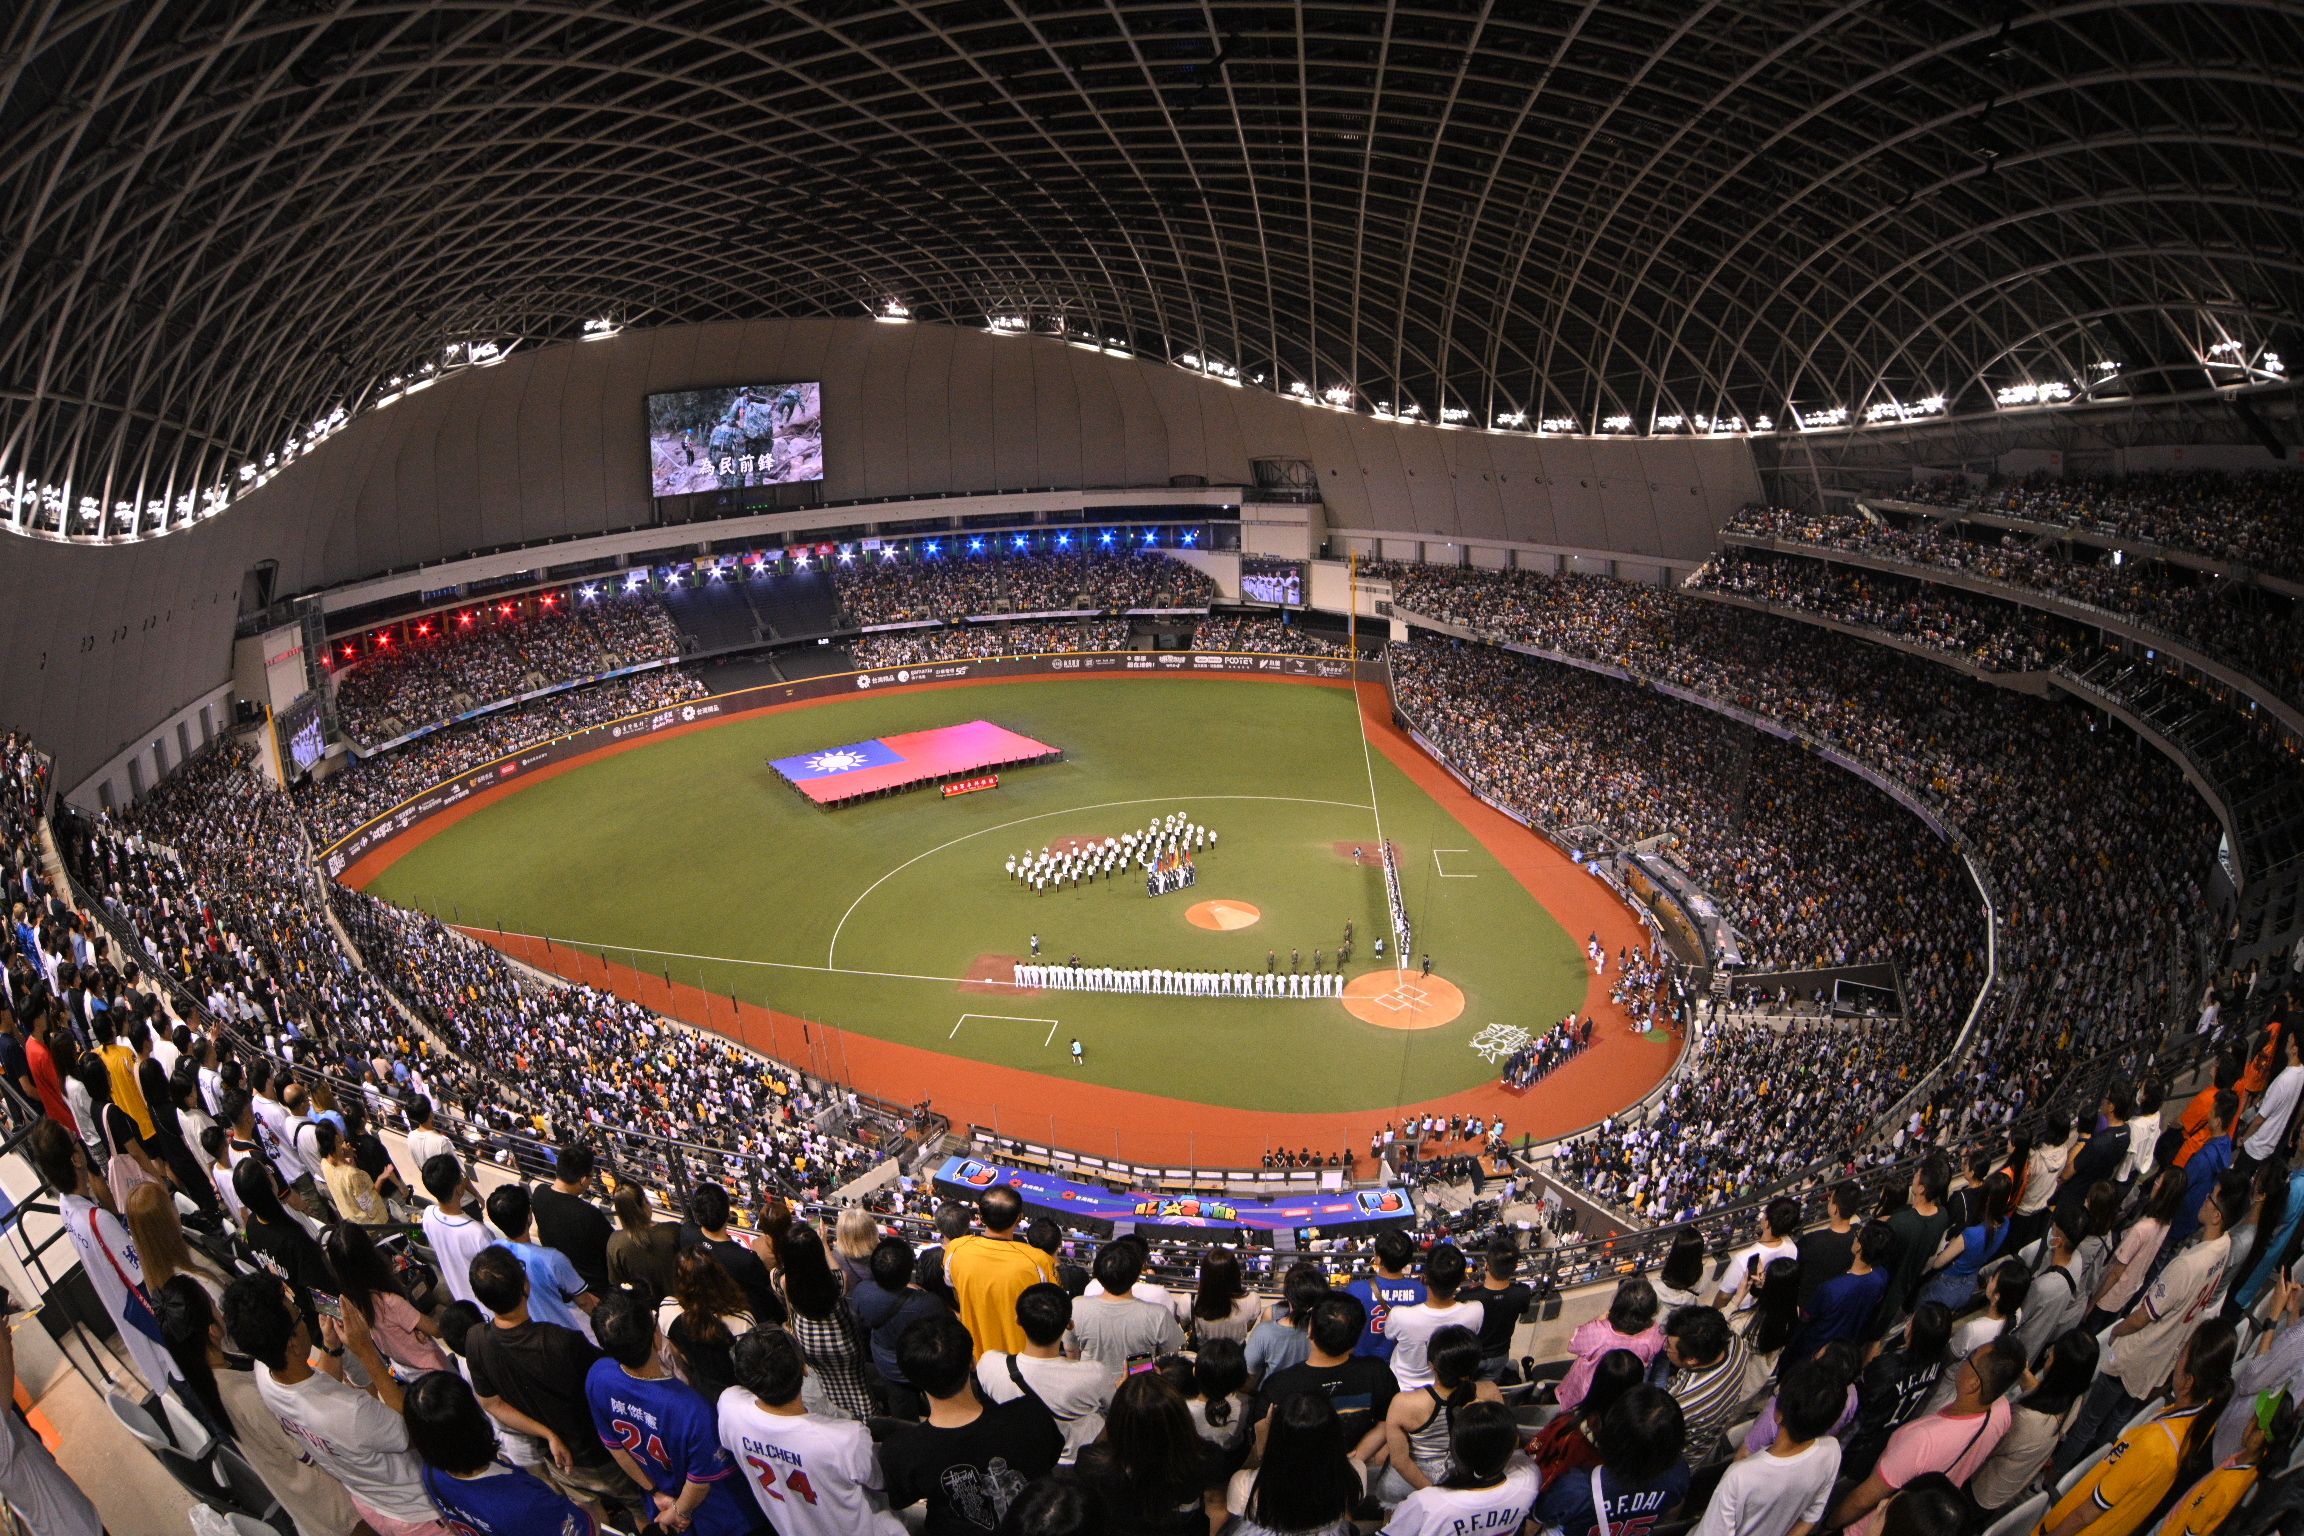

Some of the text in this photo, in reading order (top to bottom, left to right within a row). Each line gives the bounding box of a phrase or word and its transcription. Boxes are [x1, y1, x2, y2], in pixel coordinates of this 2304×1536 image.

[699, 453, 775, 476] 為民前鋒
[1224, 656, 1253, 665] FOOTER
[1180, 1199, 1237, 1220] STAR
[1372, 1289, 1415, 1302] M.PENG
[611, 1397, 658, 1430] 陳傑憲
[1884, 1387, 1928, 1428] 17
[612, 1419, 673, 1471] 24
[742, 1436, 802, 1468] C.H.CHEN
[746, 1454, 818, 1506] 24
[1603, 1490, 1665, 1517] P.F.DAI
[1453, 1507, 1520, 1536] P.F.DAI
